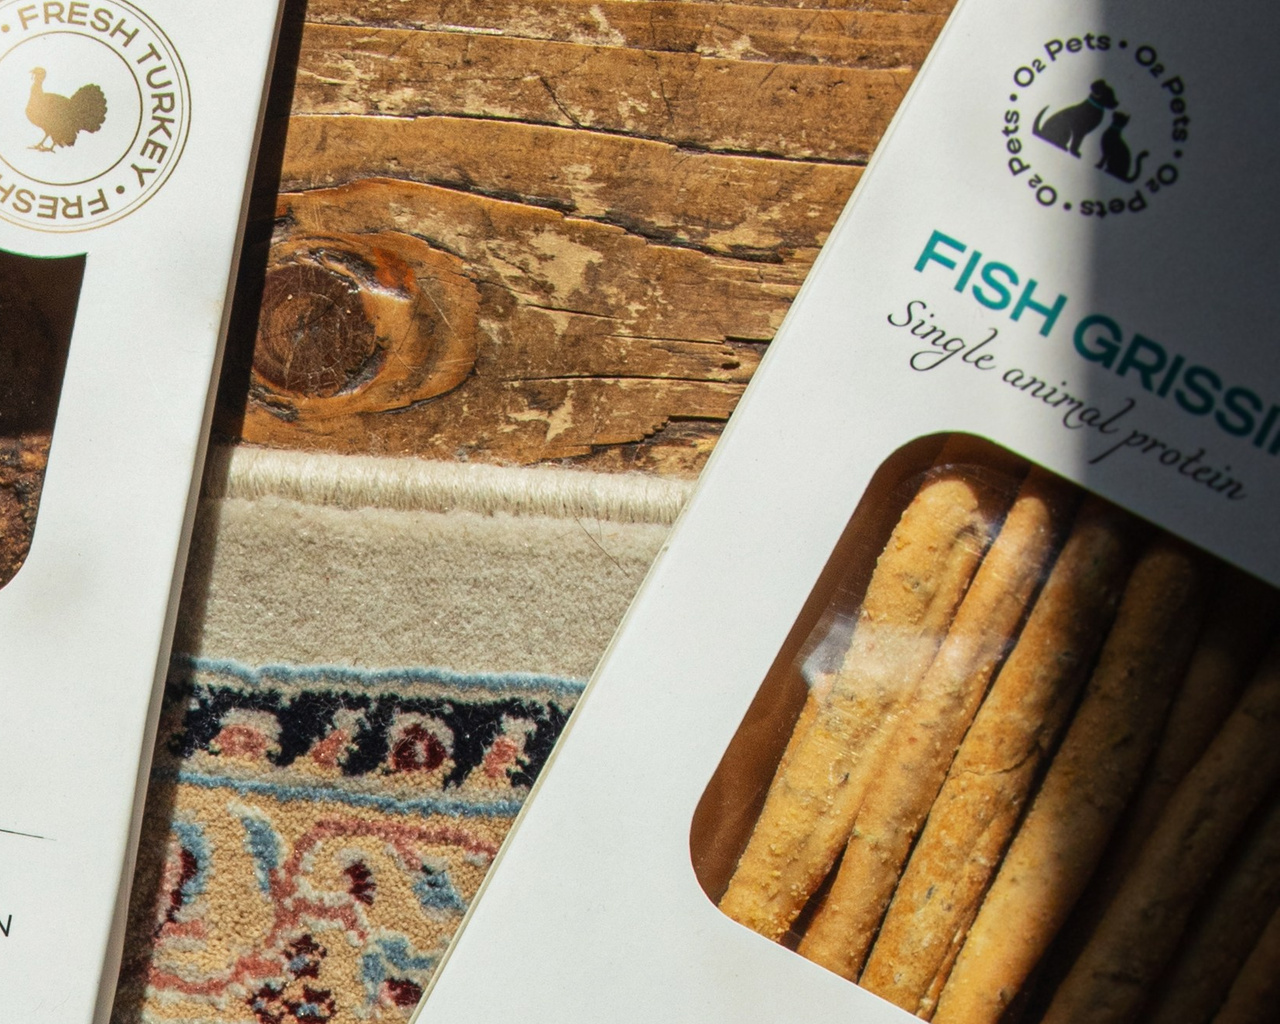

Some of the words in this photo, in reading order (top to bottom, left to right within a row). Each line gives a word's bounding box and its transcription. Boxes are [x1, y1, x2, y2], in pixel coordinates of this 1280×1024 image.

[1044, 33, 1111, 61] Pets
[17, 1, 139, 48] FRESH
[131, 43, 175, 188] TURKEY
[1162, 77, 1190, 142] Pets
[1002, 110, 1031, 176] Pets
[1080, 190, 1147, 219] Pets
[913, 230, 1068, 338] FISH
[1073, 313, 1280, 458] GRISSI
[887, 300, 999, 372] Single
[1002, 368, 1135, 435] animal
[1090, 428, 1247, 501] protein
